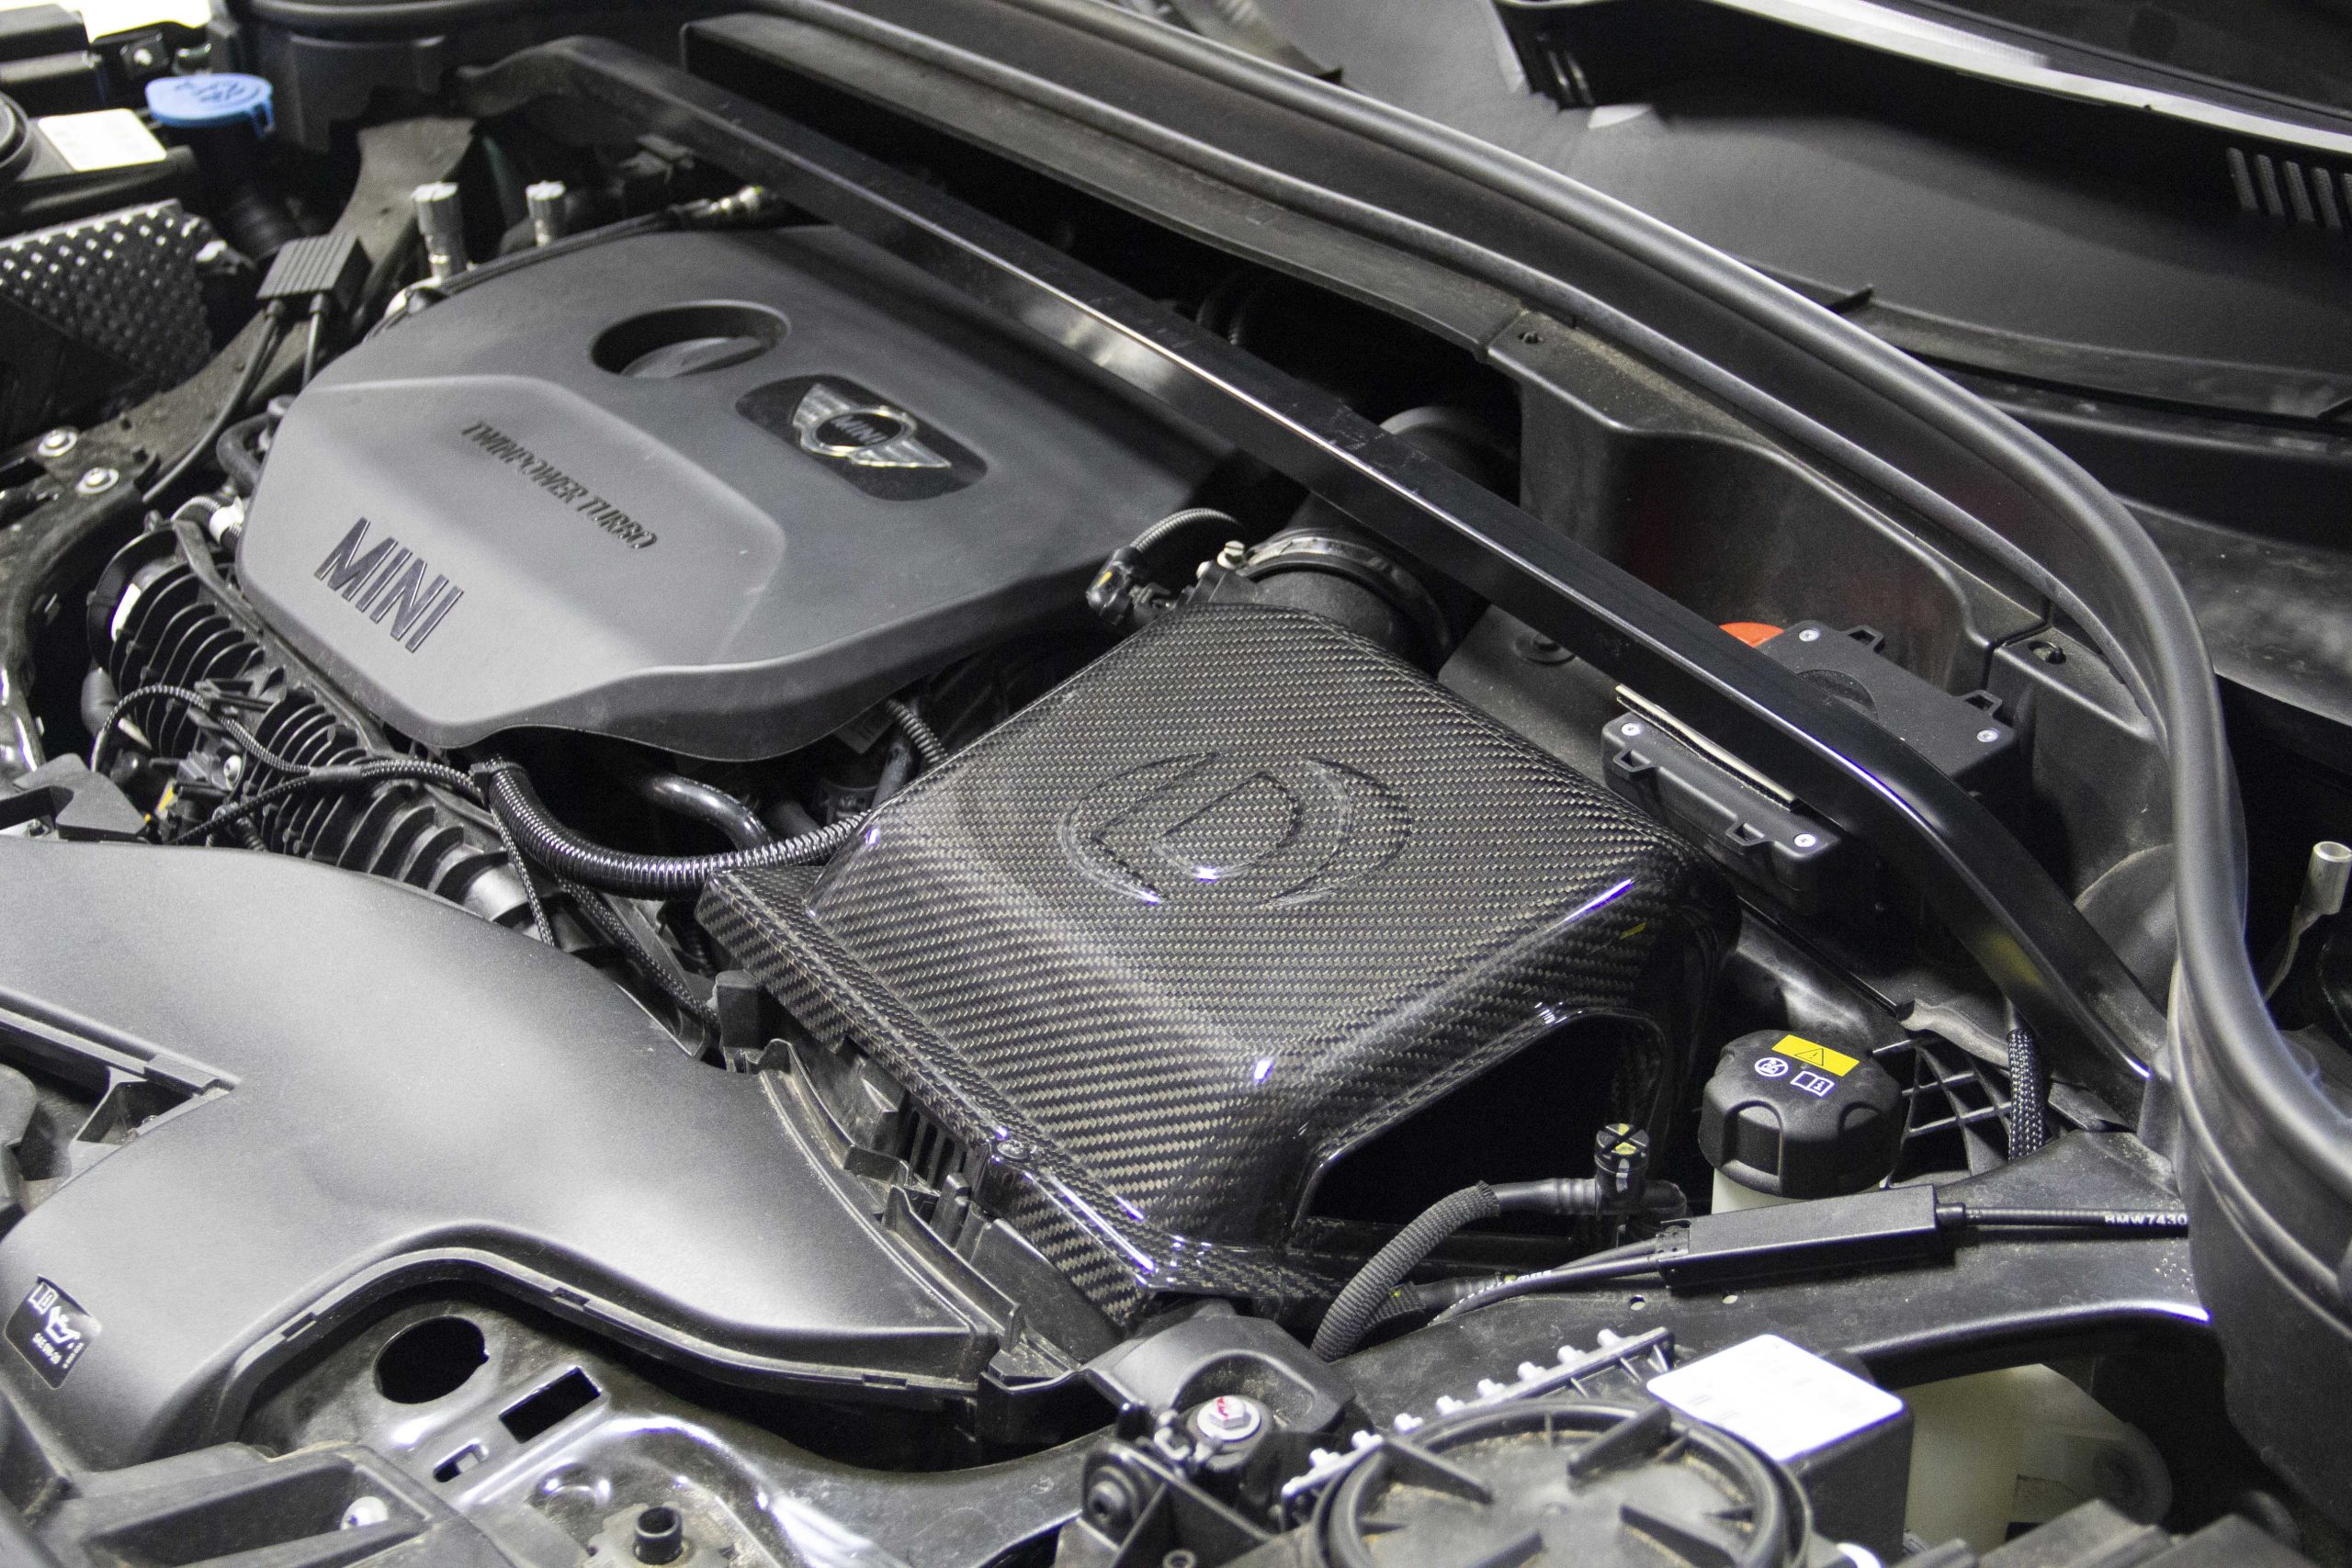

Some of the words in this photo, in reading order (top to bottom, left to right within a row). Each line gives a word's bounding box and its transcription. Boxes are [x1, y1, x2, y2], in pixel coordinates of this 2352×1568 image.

[461, 420, 589, 504] TWINPOWER
[576, 495, 658, 549] TURBO
[313, 516, 465, 654] MINI
